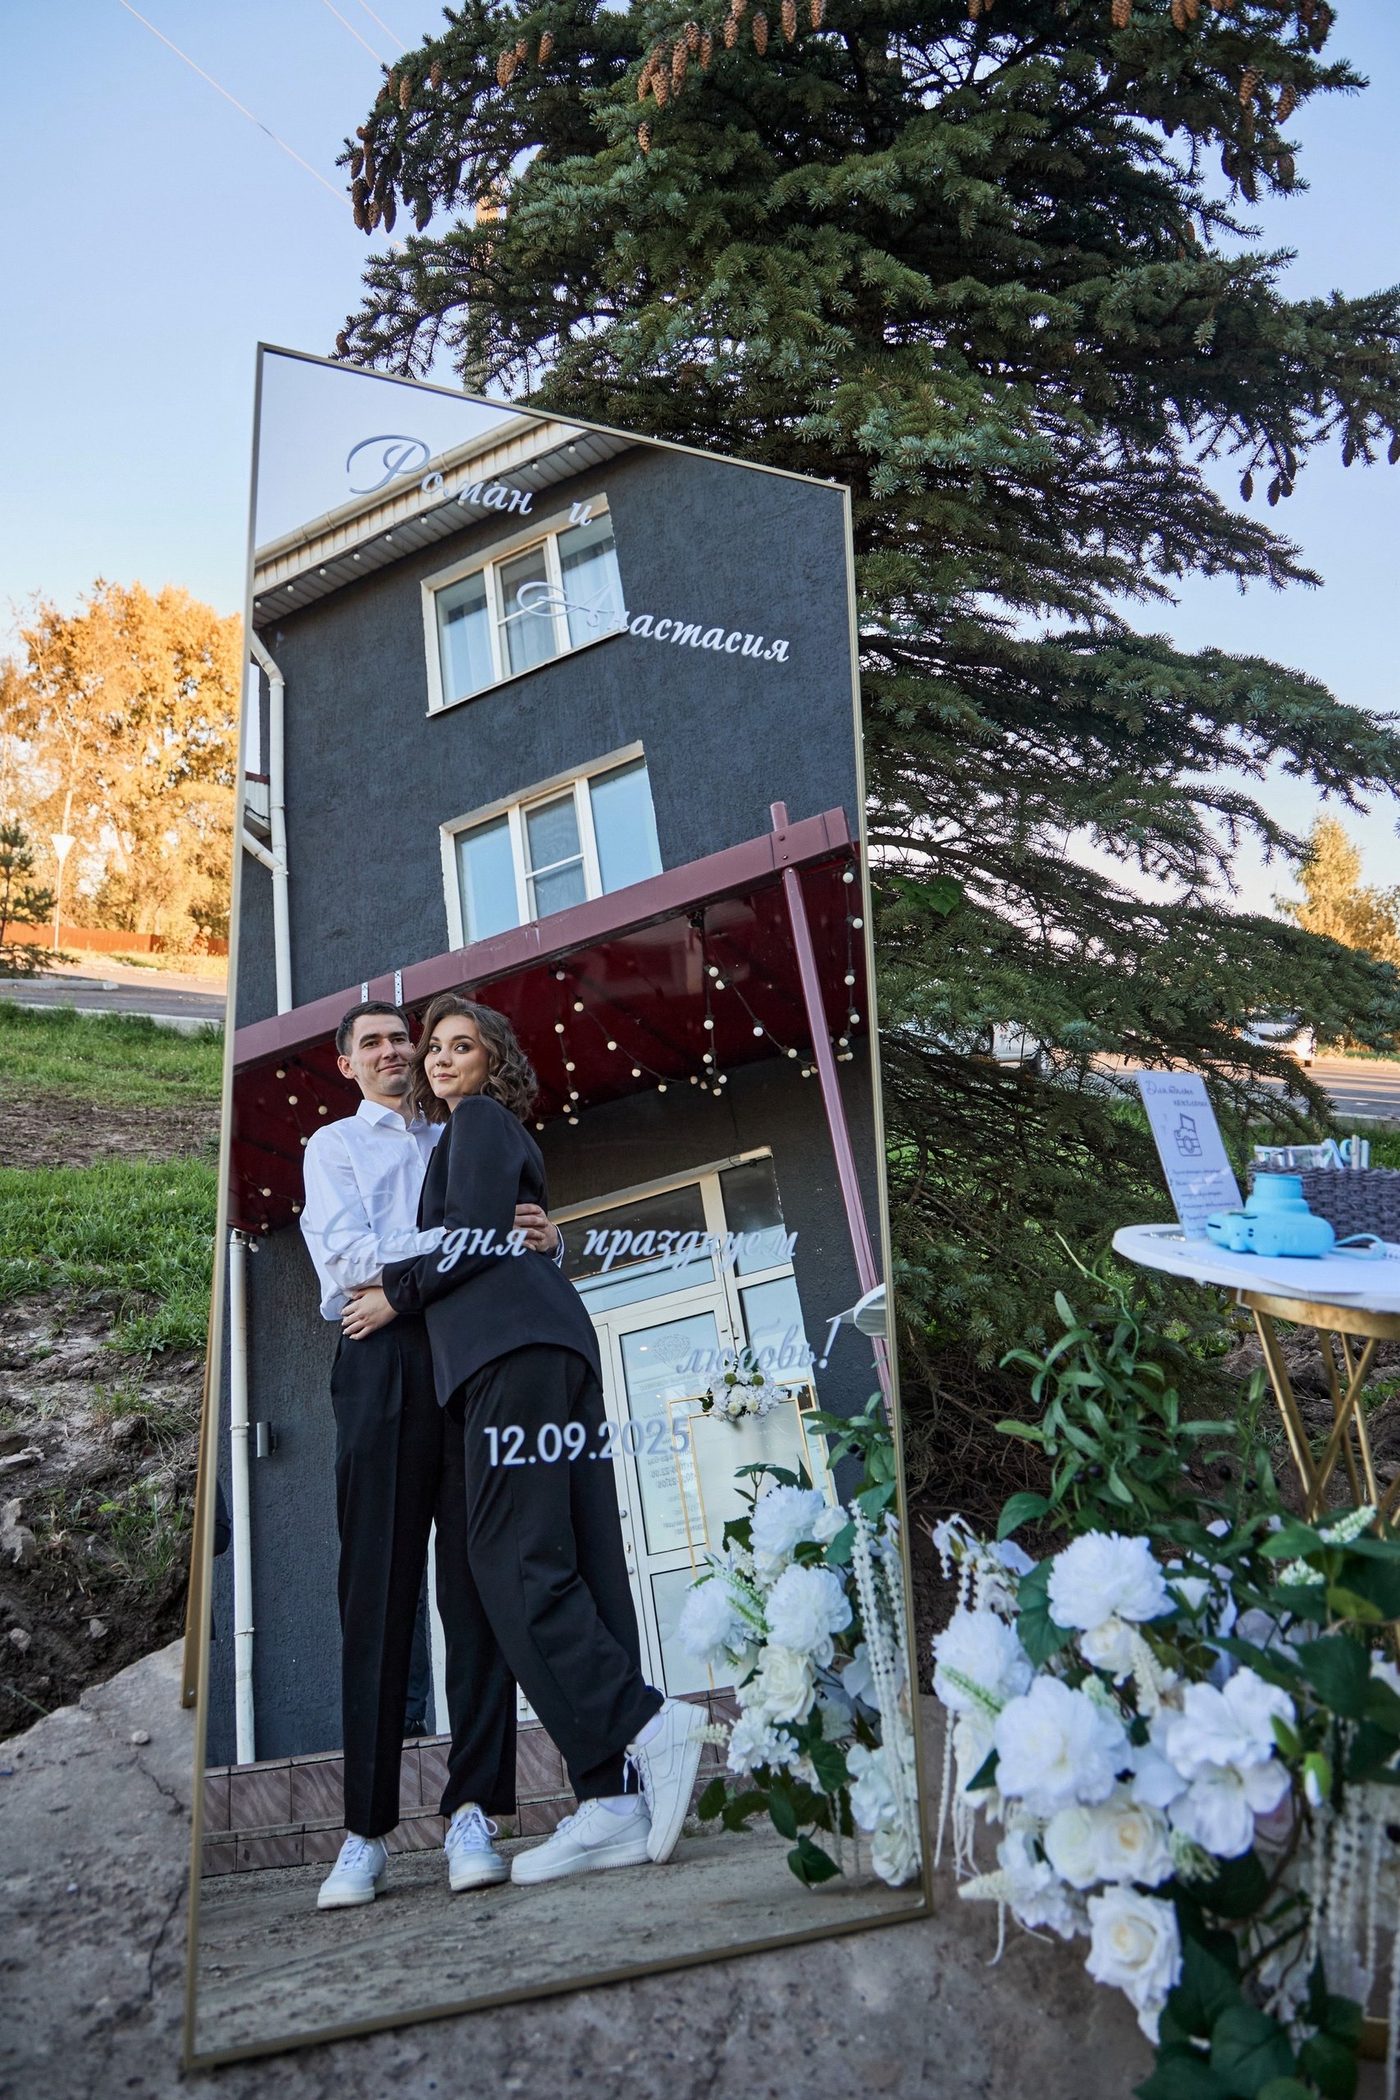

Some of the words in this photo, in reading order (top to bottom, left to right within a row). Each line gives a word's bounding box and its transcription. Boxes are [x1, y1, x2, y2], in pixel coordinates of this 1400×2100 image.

[346, 434, 533, 515] Роман
[568, 501, 593, 527] и
[516, 581, 790, 663] Анастасия
[304, 1190, 529, 1273] Сегодня
[583, 1227, 799, 1272] празднуем
[676, 1316, 841, 1372] любовь!
[483, 1417, 691, 1467] 12.09.2025
